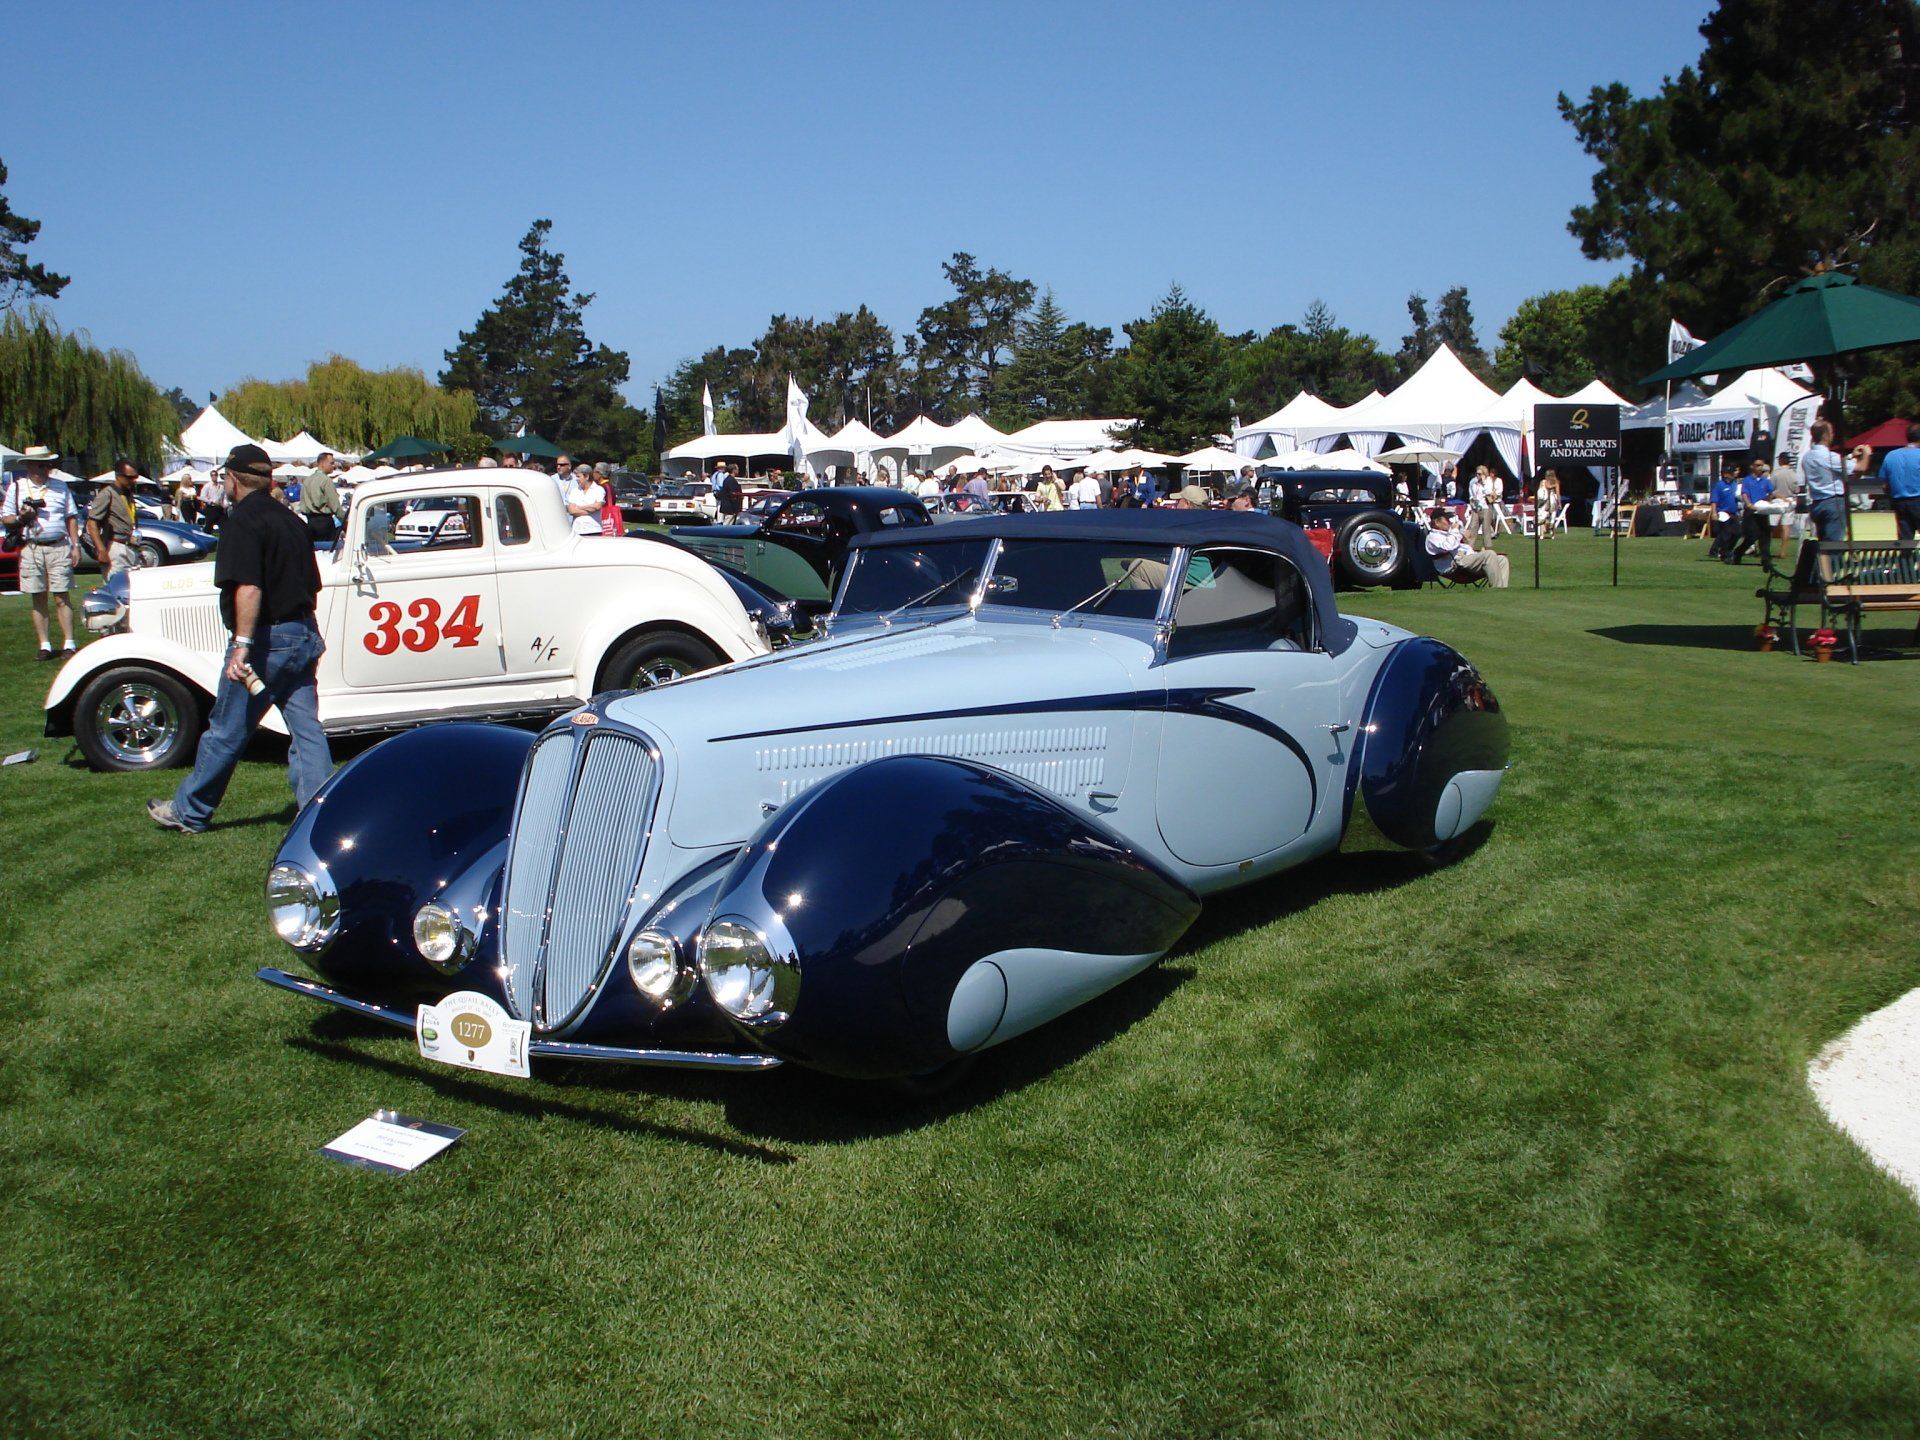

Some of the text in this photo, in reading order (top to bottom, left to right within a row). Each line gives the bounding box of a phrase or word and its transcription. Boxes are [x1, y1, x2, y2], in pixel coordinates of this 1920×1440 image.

[1678, 422, 1701, 443] ROAD
[1714, 420, 1745, 441] TRACK
[1787, 407, 1808, 441] TRACK
[1540, 439, 1558, 448] PRE
[1564, 439, 1584, 448] WAR
[1586, 439, 1617, 448] SPORTS
[1550, 449, 1606, 458] AND RACING
[363, 595, 484, 656] 334
[531, 636, 559, 663] A/F
[458, 1022, 486, 1039] 1277
